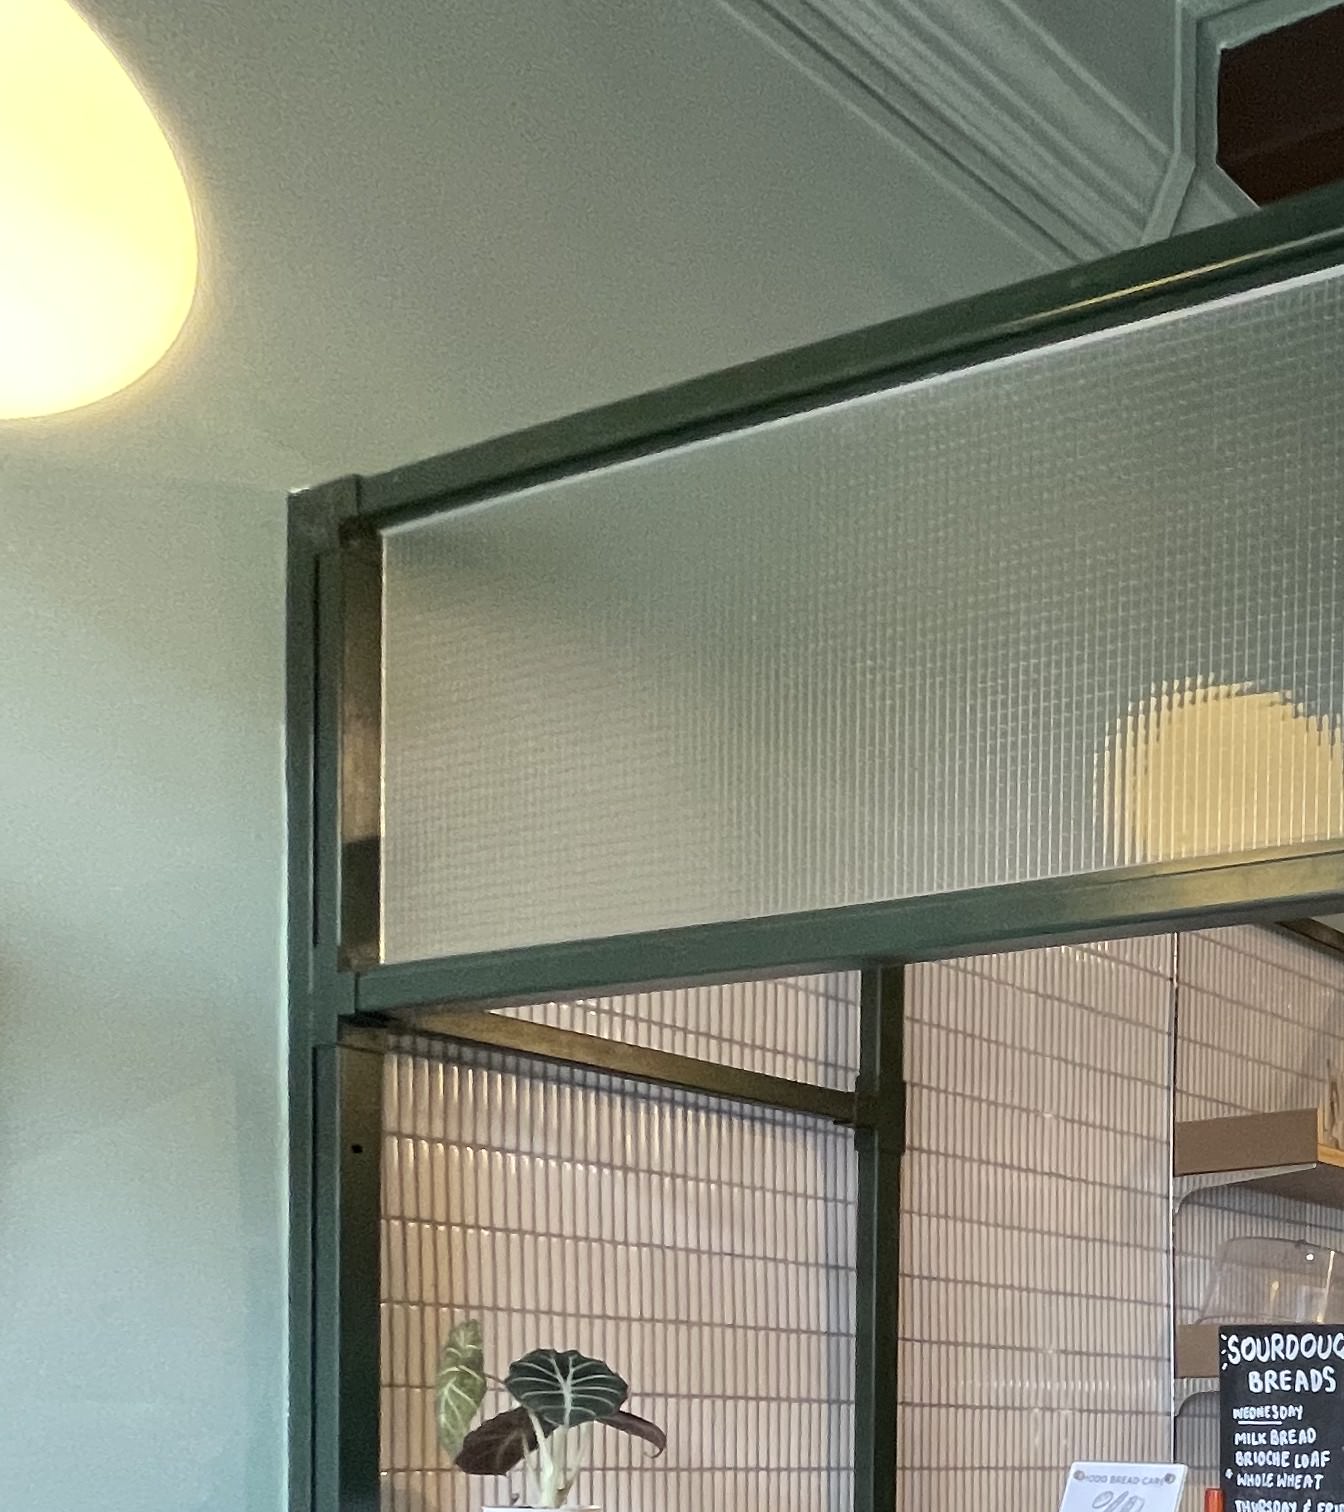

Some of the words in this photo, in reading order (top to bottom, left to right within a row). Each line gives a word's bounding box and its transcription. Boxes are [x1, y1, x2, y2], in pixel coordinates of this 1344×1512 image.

[1248, 1365, 1336, 1393] BREADS
[1233, 1405, 1303, 1420] WEDNESDAY
[1234, 1432, 1267, 1445] MILK
[1270, 1428, 1317, 1445] BREAD
[1235, 1451, 1290, 1467] BRIOCHE
[1294, 1451, 1331, 1468] LOAF
[1110, 1475, 1140, 1484] BREAD
[1236, 1473, 1274, 1488] WHOLE
[1277, 1473, 1324, 1490] WHEAT
